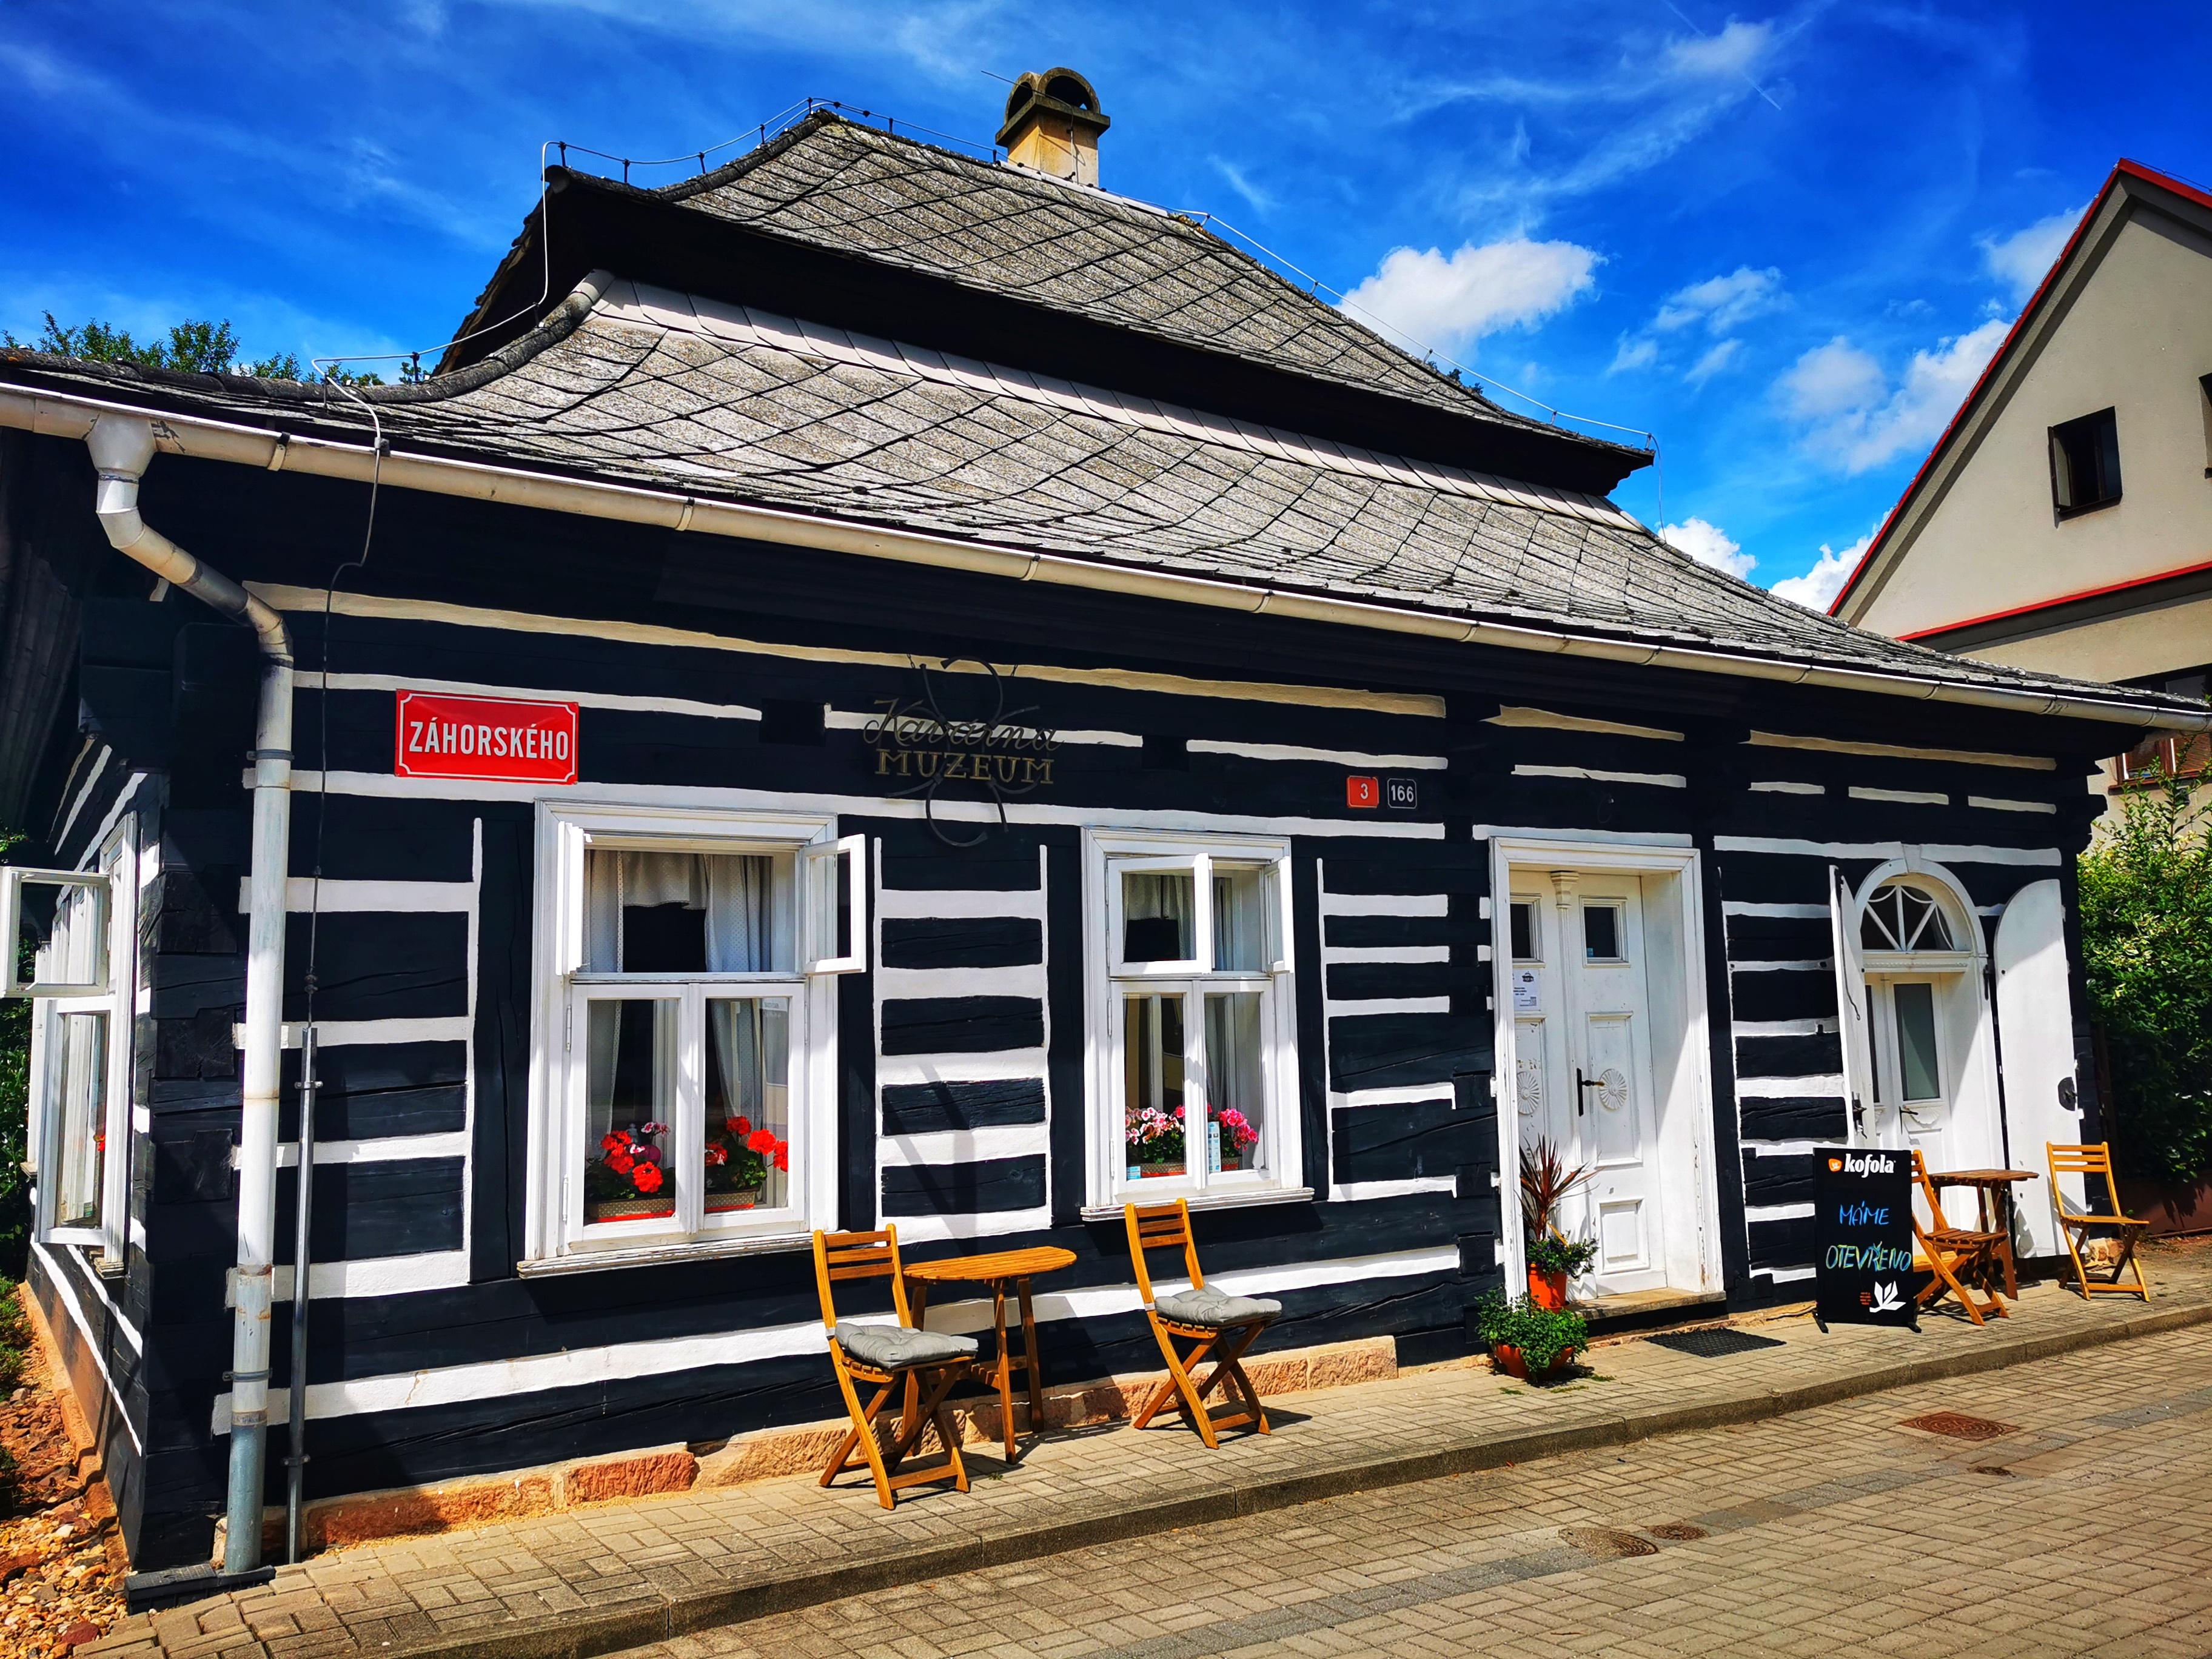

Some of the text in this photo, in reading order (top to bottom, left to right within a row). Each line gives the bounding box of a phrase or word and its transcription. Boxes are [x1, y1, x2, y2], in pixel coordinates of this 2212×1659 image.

[409, 716, 569, 760] ZÁHORSKÉHO
[863, 697, 1065, 751] Kavárna
[874, 748, 1054, 785] MUZEUM
[1360, 783, 1369, 800] 3
[1391, 785, 1414, 802] 166
[1844, 1153, 1894, 1178] kofola
[1839, 1201, 1889, 1226] MÁME
[1826, 1241, 1912, 1272] OTEVŘENO
